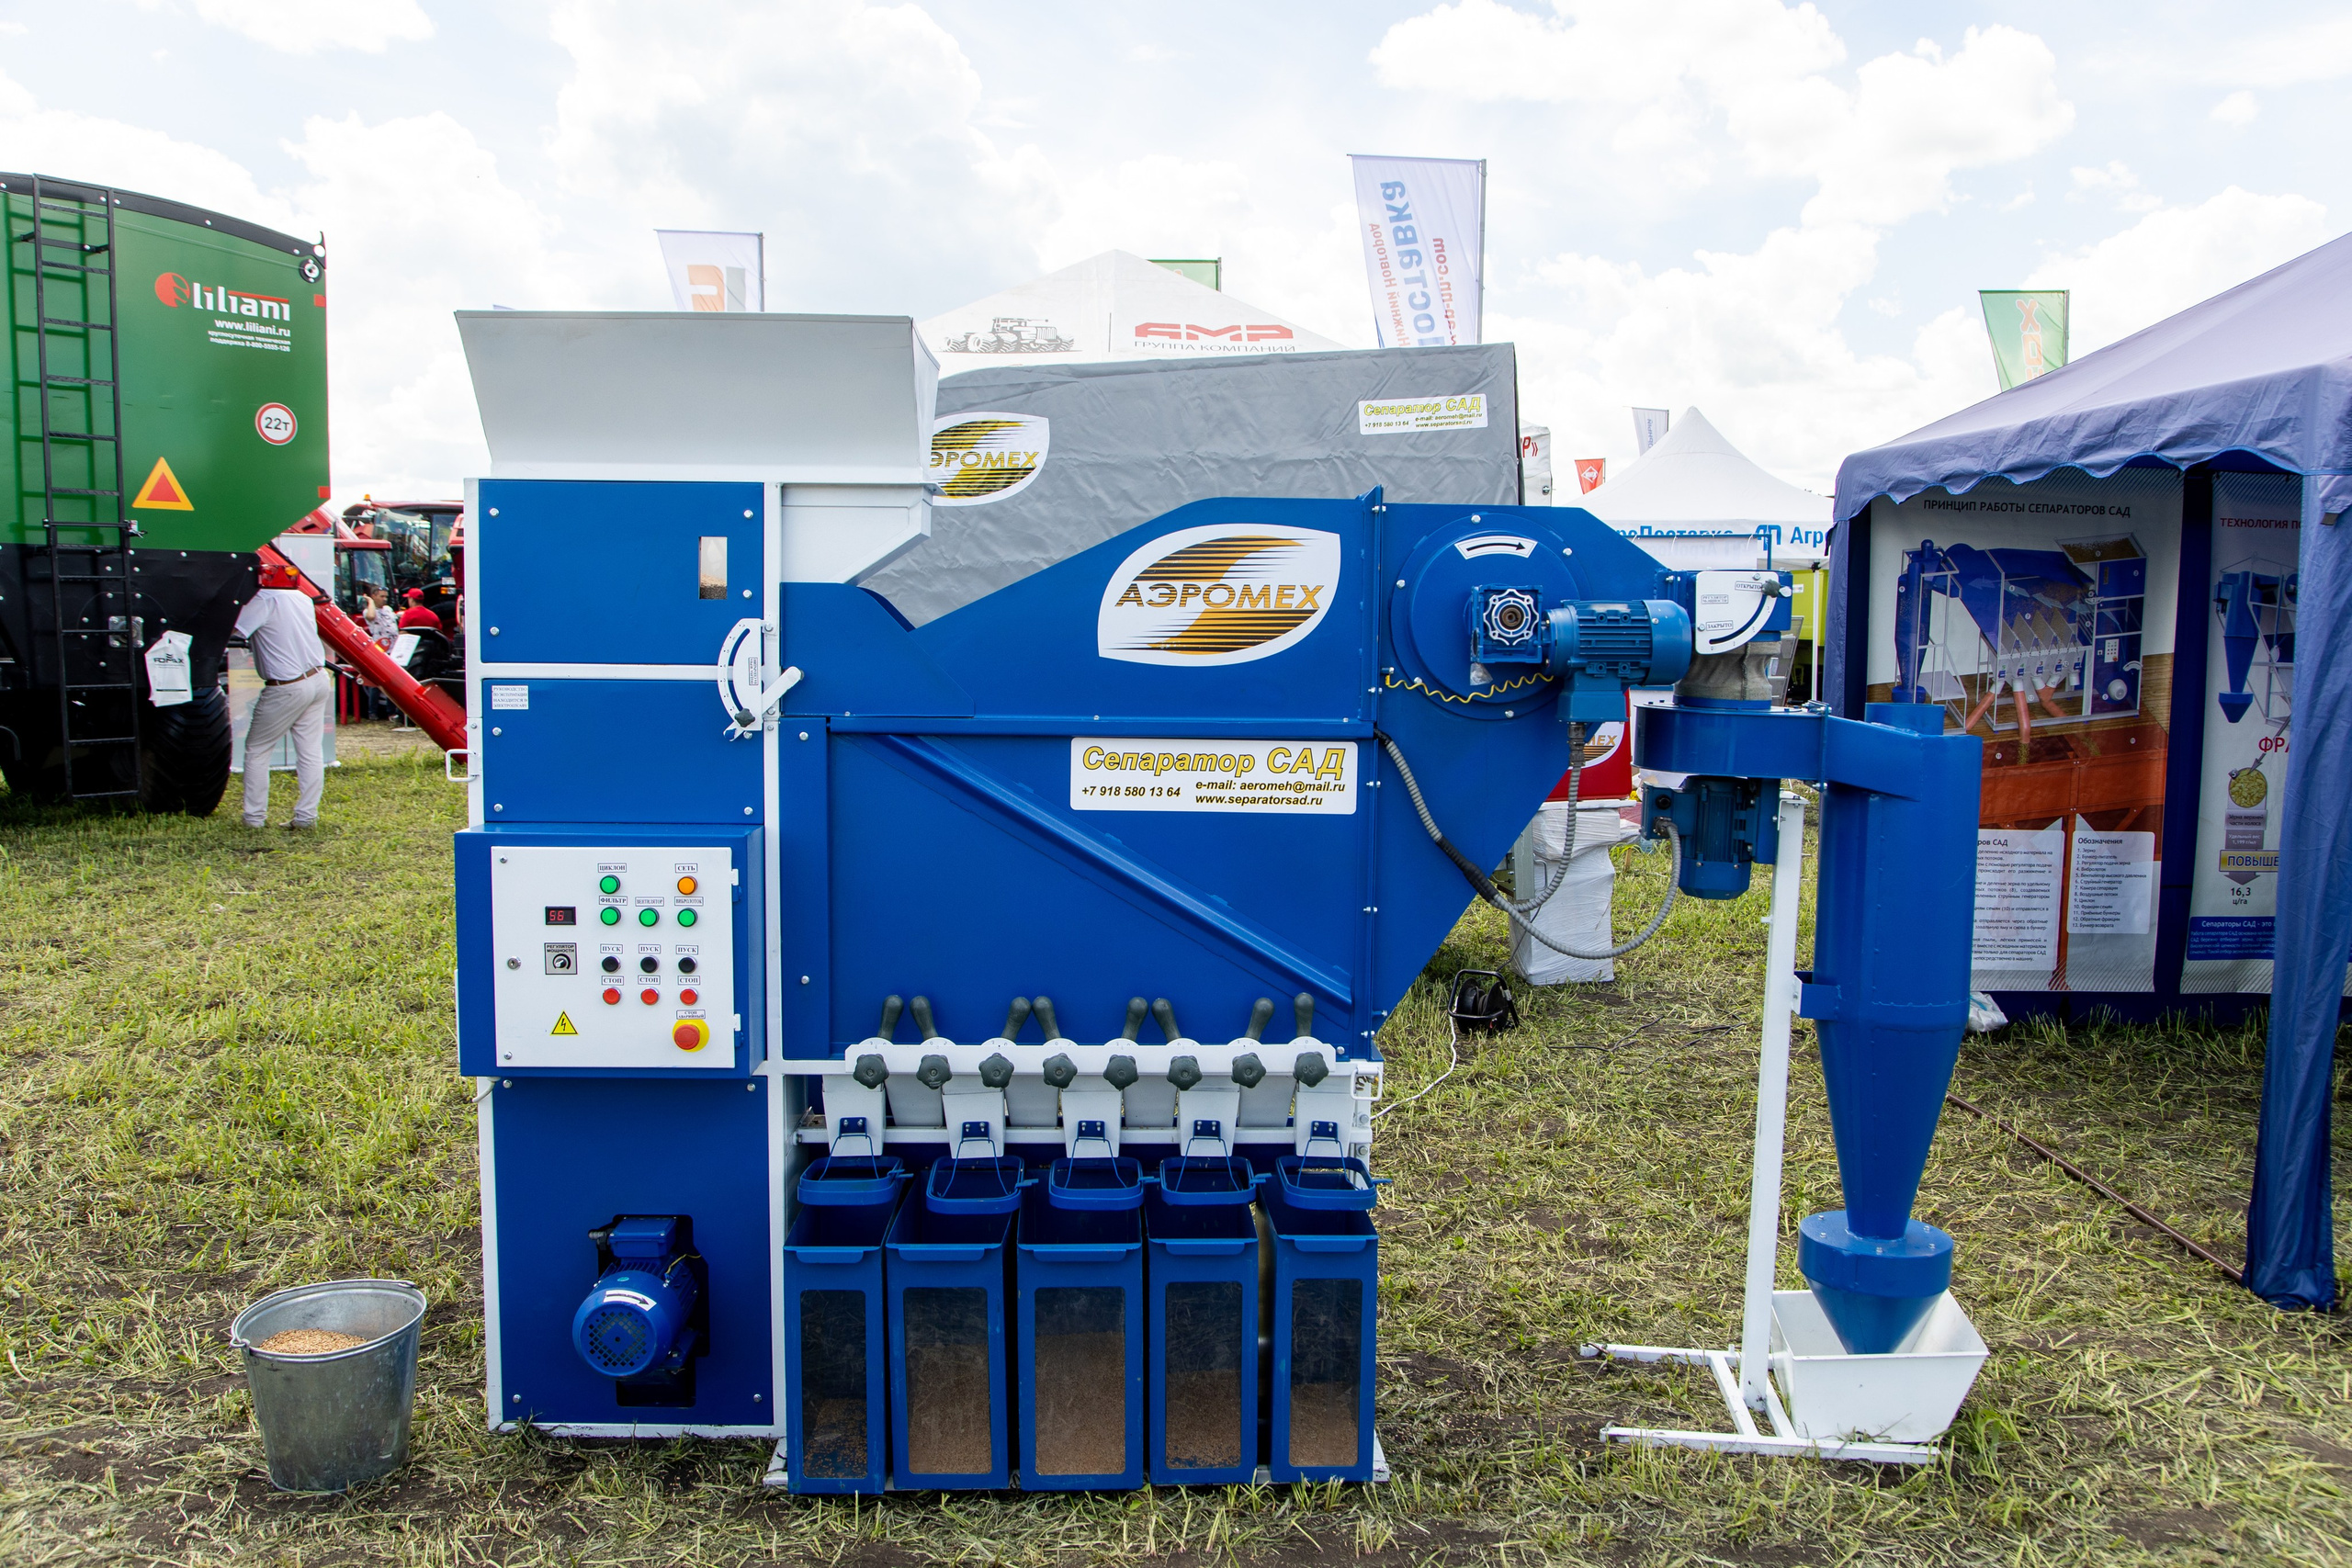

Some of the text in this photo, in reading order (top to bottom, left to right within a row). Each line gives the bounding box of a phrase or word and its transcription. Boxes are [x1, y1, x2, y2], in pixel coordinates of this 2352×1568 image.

[193, 281, 291, 321] liliani
[214, 319, 291, 337] www.liliani.ru
[1135, 341, 1295, 353] ГРУППА КОМПАНИЙ
[1364, 397, 1481, 417] Сепаратор САД
[1415, 420, 1473, 428] www.separatorsad.ru
[930, 450, 1039, 468] ЭРОМЕХ
[1923, 500, 2132, 518] ПРИНЦИП РАБОТЫ СЕПАРАТОРОВ САД
[2220, 517, 2289, 529] ТЕХНОЛОГИЯ
[1114, 582, 1326, 610] АЭРОМЕХ
[1082, 746, 1346, 781] Сепаратор САД
[1081, 785, 1182, 797] +7 918 580 13 64
[1195, 780, 1346, 794] e-mail: aeromeh@mail.ru
[1195, 795, 1323, 807] www.separatorsad.ru
[1993, 839, 2008, 847] САД
[2231, 887, 2251, 897] 16,3
